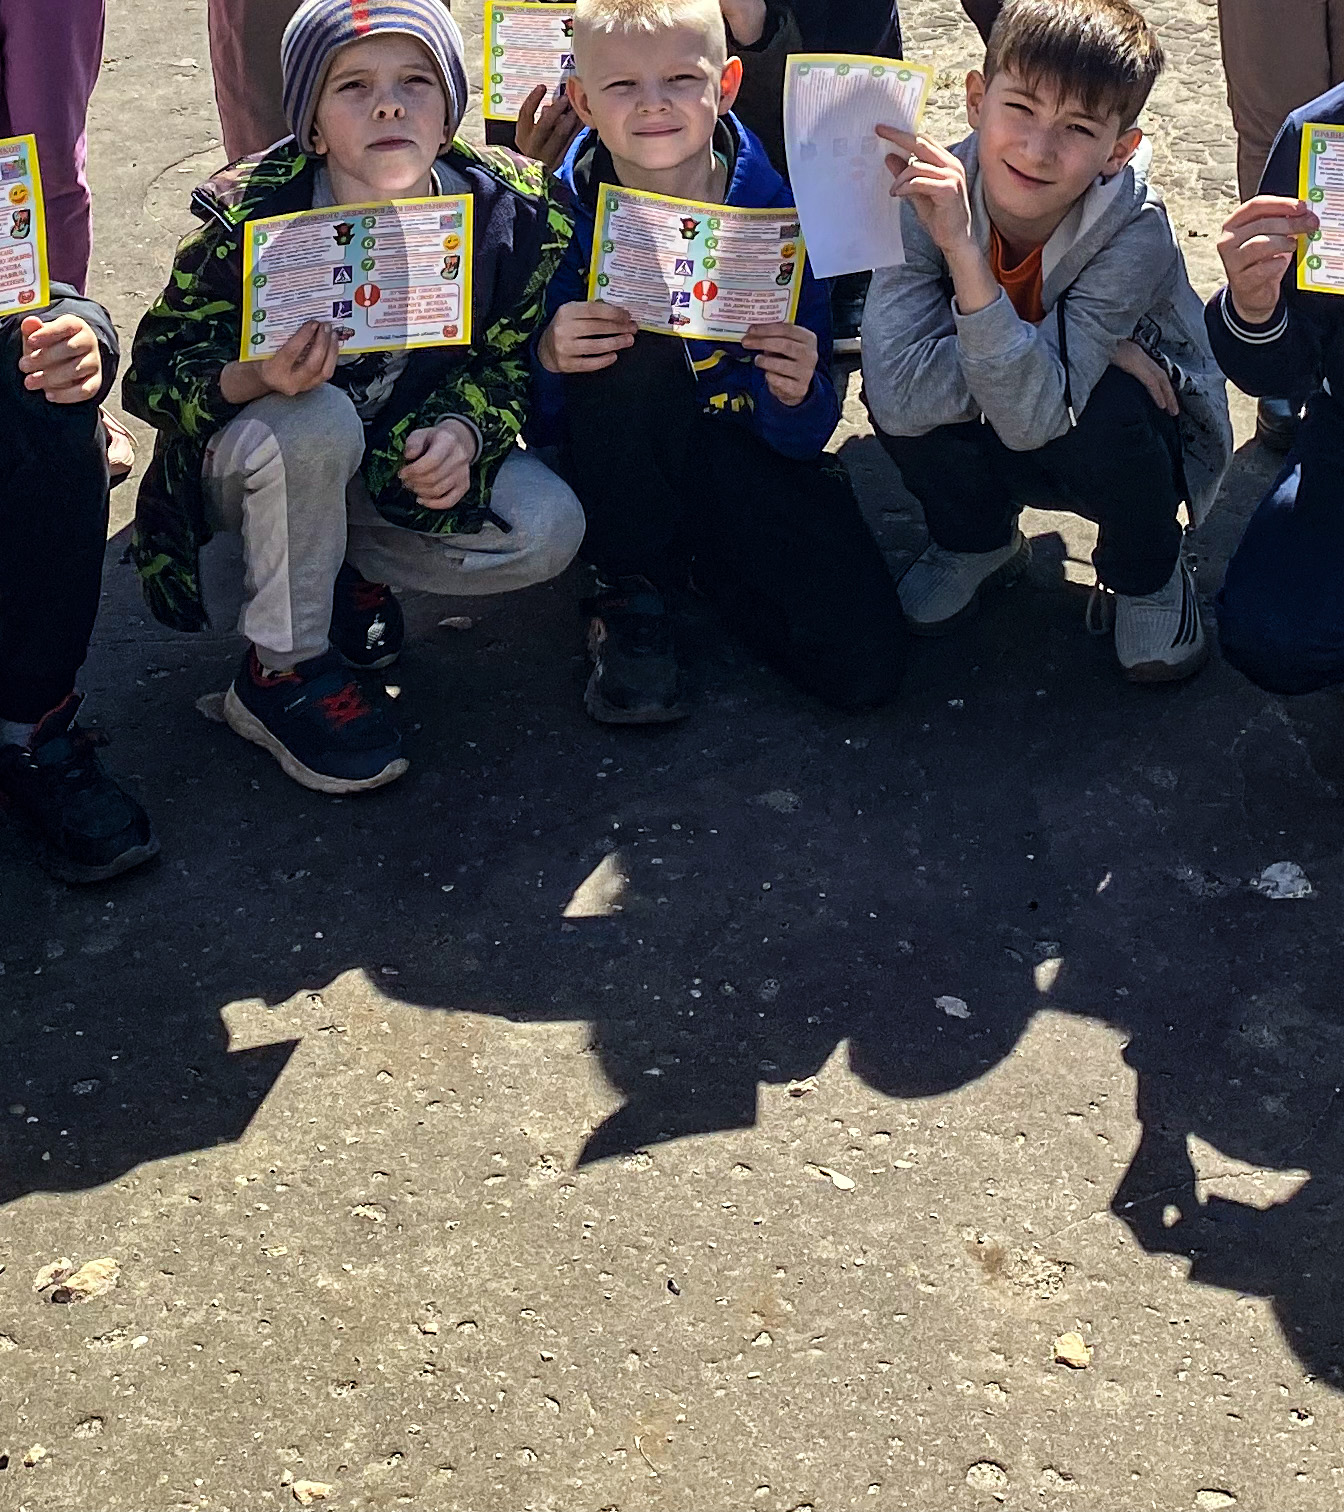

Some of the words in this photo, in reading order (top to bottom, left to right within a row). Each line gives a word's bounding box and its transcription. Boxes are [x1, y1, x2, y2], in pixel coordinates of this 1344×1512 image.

[1317, 142, 1322, 151] 1
[1312, 190, 1321, 200] 2
[610, 201, 614, 209] 1
[365, 218, 373, 227] 5
[711, 220, 717, 228] 5
[258, 235, 263, 243] 1
[364, 239, 373, 247] 6
[708, 239, 715, 247] 6
[364, 260, 372, 269] 7
[1309, 258, 1319, 267] 4
[256, 277, 264, 286] 2
[255, 312, 263, 320] 3
